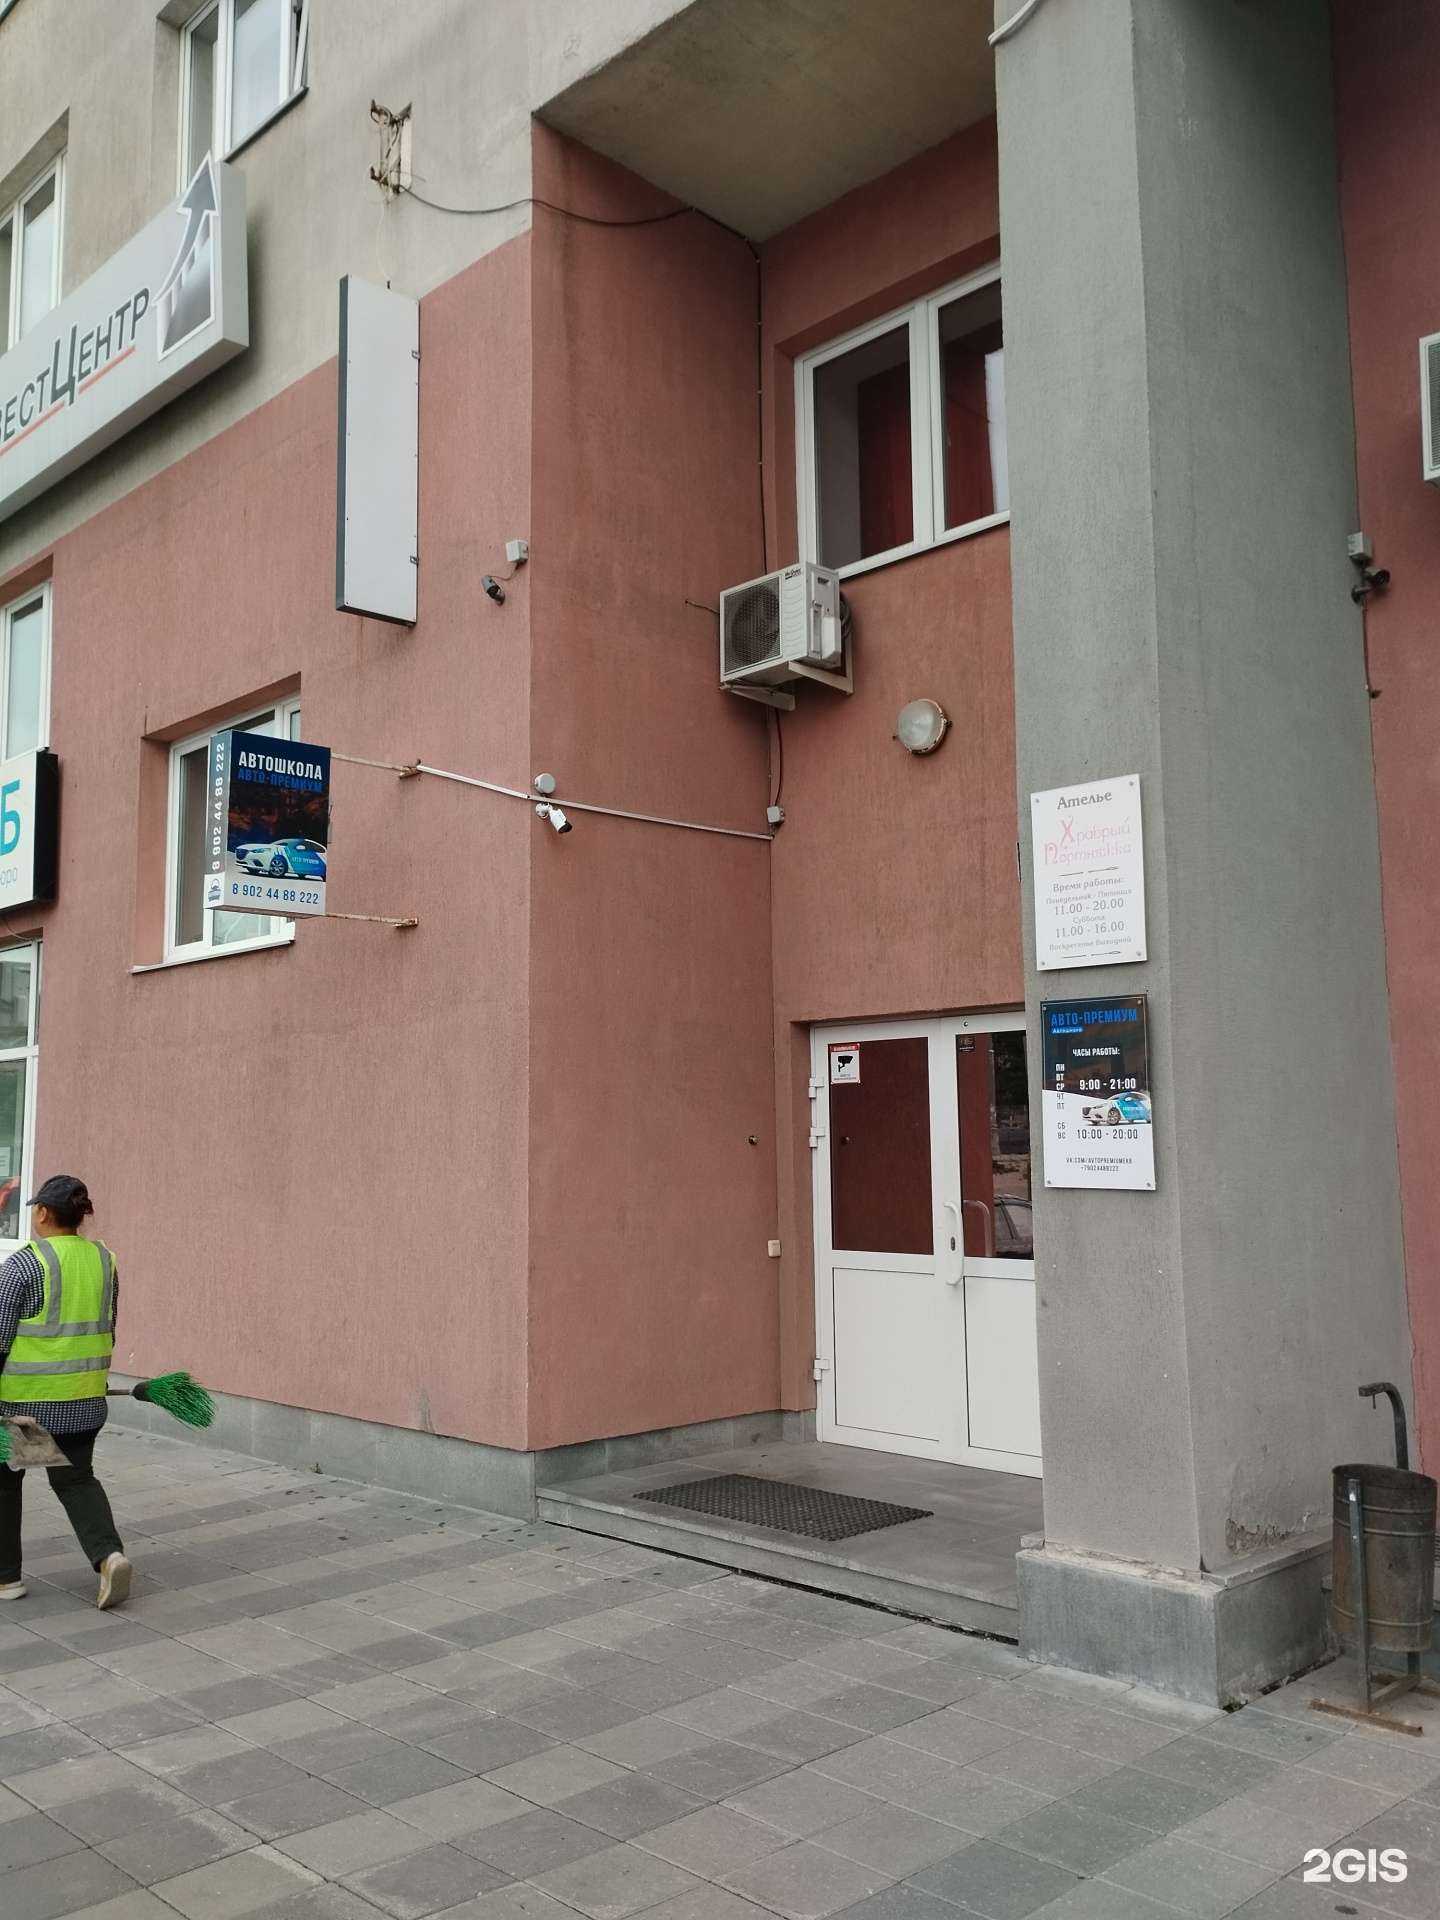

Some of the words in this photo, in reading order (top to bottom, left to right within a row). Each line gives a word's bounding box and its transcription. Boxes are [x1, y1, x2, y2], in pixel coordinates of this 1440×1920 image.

[0, 287, 150, 441] ЕСТЦЕНТР
[215, 742, 225, 772] 222
[238, 751, 322, 780] АВТОШКОЛА
[214, 777, 223, 797] 88
[1057, 791, 1113, 810] Ателье
[213, 801, 223, 820] 44
[212, 826, 222, 856] 902
[212, 861, 221, 871] 8
[232, 883, 239, 895] 8
[242, 884, 263, 898] 902
[266, 887, 279, 900] 44
[283, 889, 296, 902] 88
[299, 891, 319, 905] 222
[1055, 903, 1083, 916] 11.00
[1093, 898, 1124, 911] 20.00
[1056, 926, 1084, 938] 11.00
[1095, 920, 1125, 934] 16.00
[1051, 1008, 1137, 1027] АВТО-ПРЕМИУМ
[1072, 1048, 1091, 1057] ЧАСЫ
[1092, 1047, 1121, 1057] РАБОТЫ:
[1055, 1063, 1065, 1072] ПН
[1055, 1073, 1065, 1082] ВТ
[1080, 1079, 1100, 1090] 9:00
[1110, 1078, 1136, 1090] 21:00
[1056, 1083, 1065, 1091] СР
[1057, 1122, 1066, 1130] СБ
[1077, 1129, 1102, 1139] 10:00
[1112, 1128, 1138, 1139] 20:00
